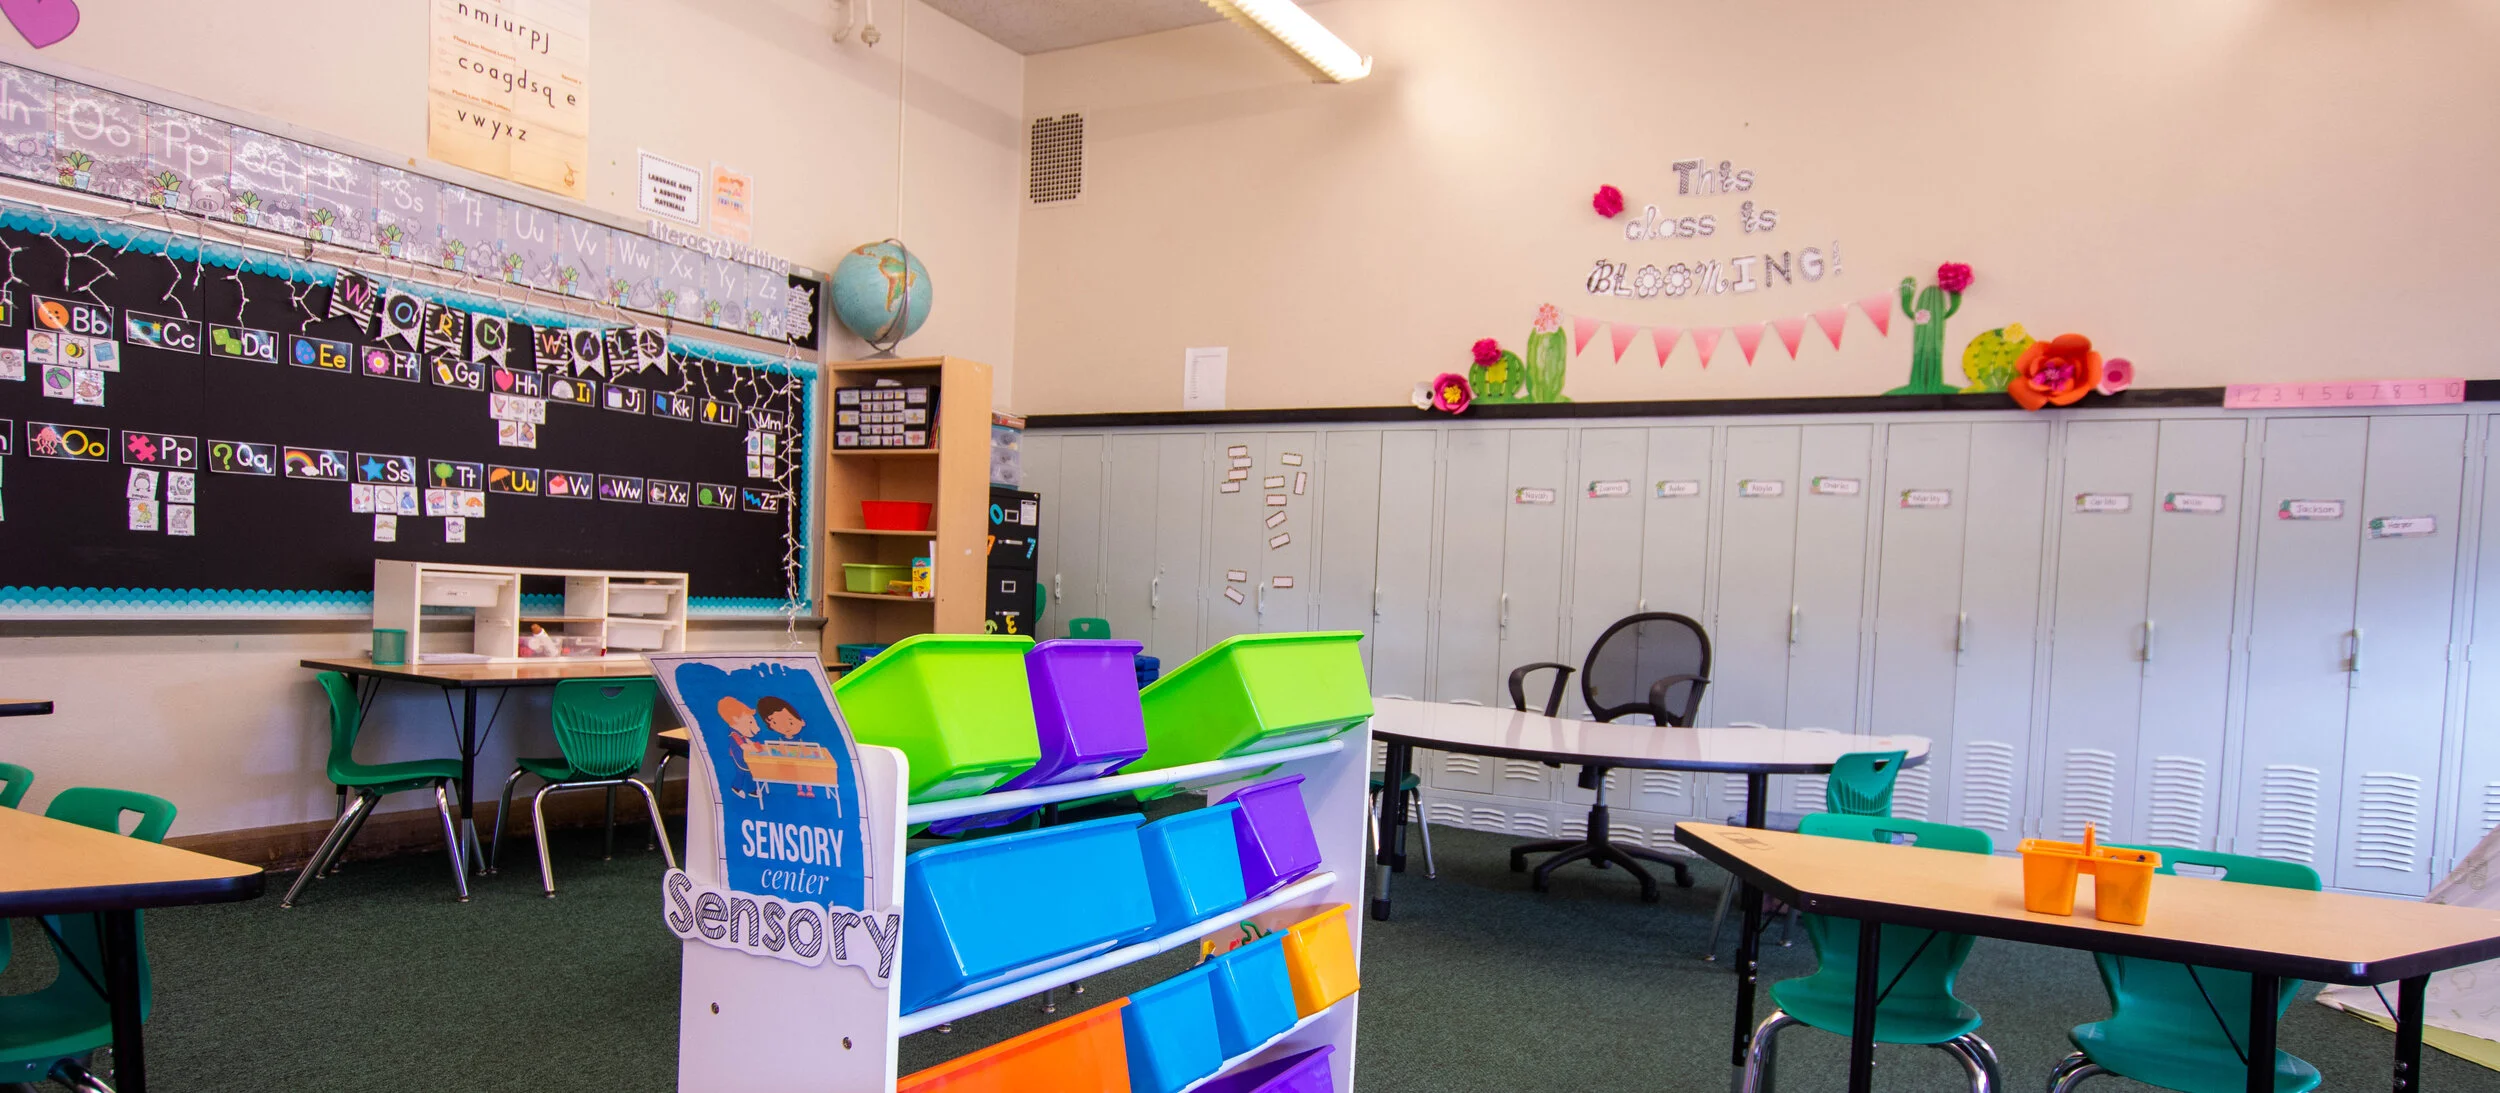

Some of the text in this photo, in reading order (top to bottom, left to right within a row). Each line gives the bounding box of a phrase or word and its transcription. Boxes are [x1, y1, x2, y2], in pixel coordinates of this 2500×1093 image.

[648, 172, 693, 193] LANGUAGE ARTS
[1672, 159, 1754, 195] This
[69, 98, 131, 147] Oo
[166, 119, 209, 178] Pp
[243, 140, 294, 193] Qq
[327, 161, 358, 195] Rr
[394, 179, 424, 213] Ss
[462, 197, 483, 227] Tt
[515, 210, 544, 243] Uu
[571, 224, 597, 256] Vv
[619, 238, 650, 270] Ww
[669, 251, 694, 281] Xx
[716, 263, 736, 298] Yy
[759, 274, 777, 300] Zz
[654, 198, 686, 213] MATERIALS
[1625, 205, 1717, 240] class
[649, 219, 719, 258] Literacy
[730, 242, 790, 275] Writing
[1586, 240, 1842, 299] BLOOMING!
[73, 306, 781, 431] Bb Cc Dd Ee Ff Gg Hh Ii Jj Kk Ll Mm
[2251, 387, 2262, 402] 2
[2273, 387, 2283, 402] 3
[2297, 385, 2304, 400] 4
[2322, 386, 2333, 400] 5
[2346, 384, 2355, 400] 6
[2371, 384, 2381, 400] 7
[2393, 384, 2402, 399] 8
[2417, 384, 2427, 399] 9
[2444, 382, 2461, 398] 10
[62, 430, 777, 511] Oo Pp Qq Rr Ss Tt Uu Vv Ww Xx Yy Zz
[2296, 503, 2336, 514] Jackson
[741, 819, 844, 868] SENSORY
[761, 867, 830, 896] center
[668, 873, 900, 979] Sensory
